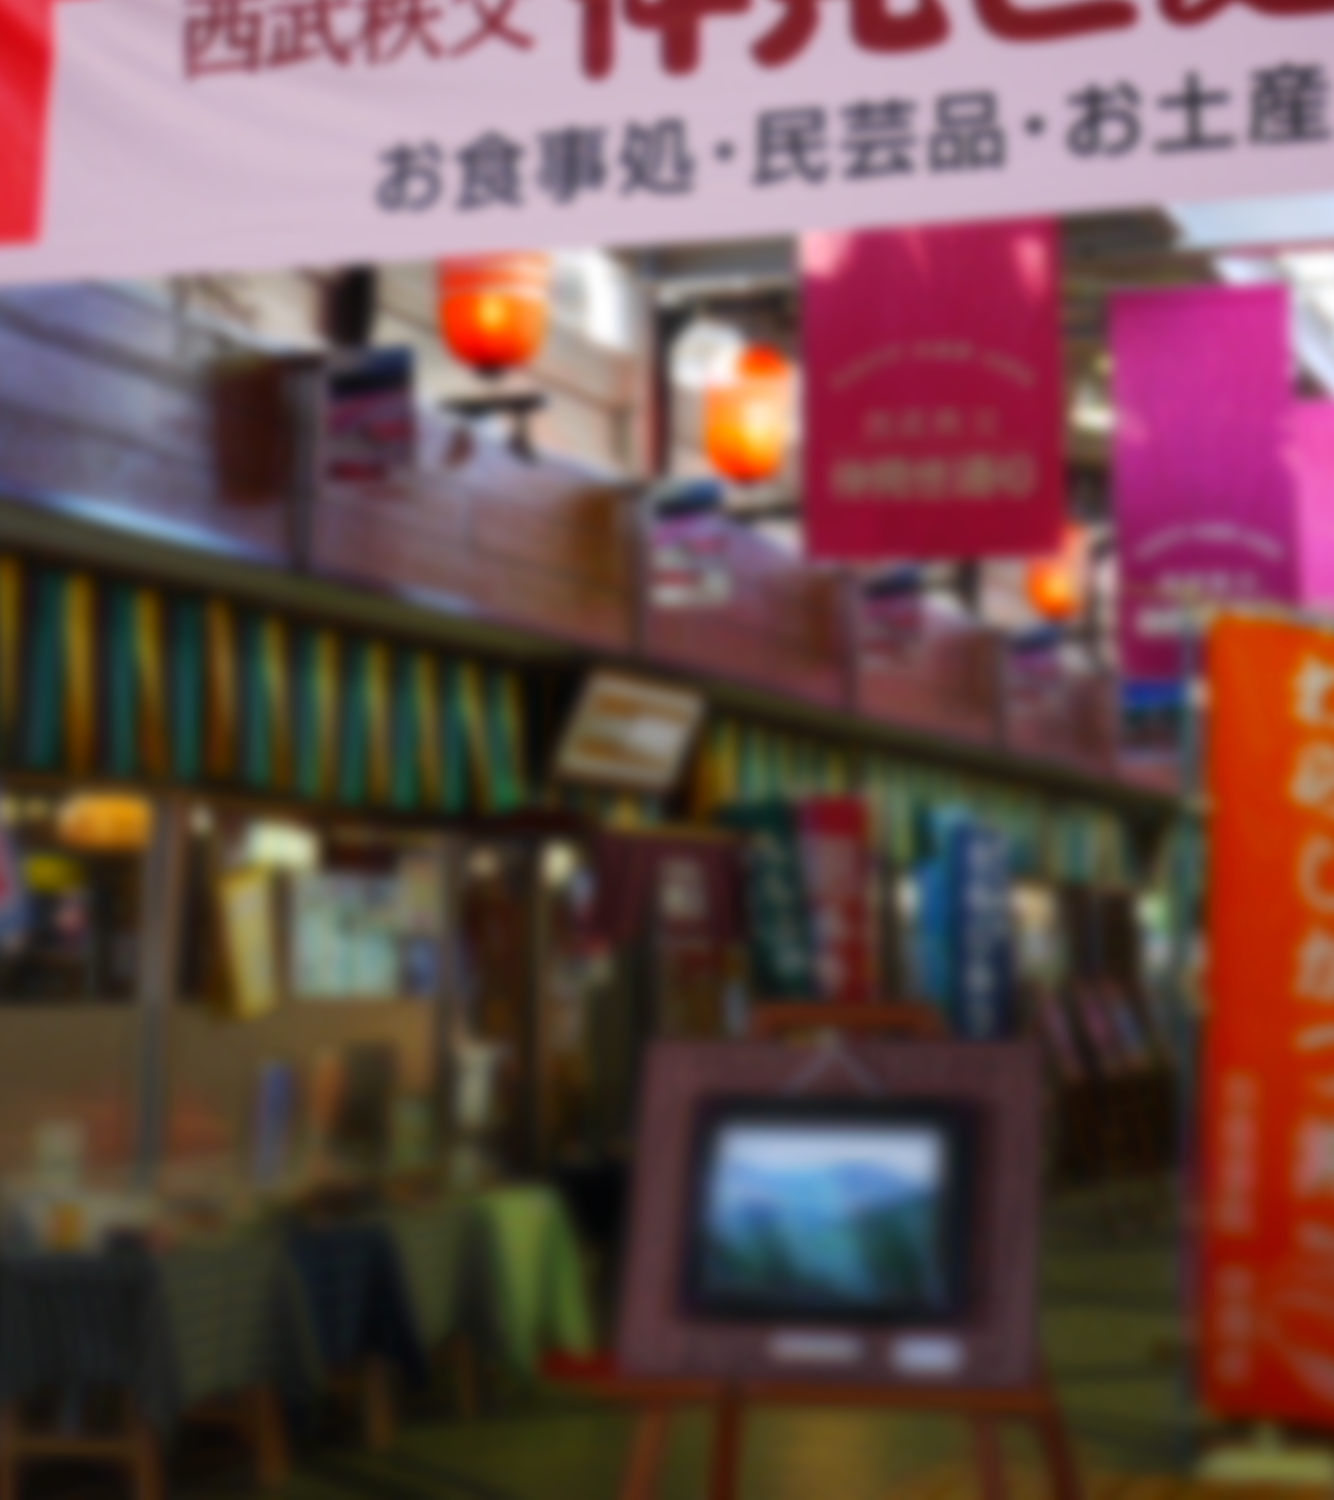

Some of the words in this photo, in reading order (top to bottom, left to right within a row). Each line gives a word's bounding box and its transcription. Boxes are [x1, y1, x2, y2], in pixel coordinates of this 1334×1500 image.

[373, 59, 1334, 215] お食事処・民芸品・お土産
